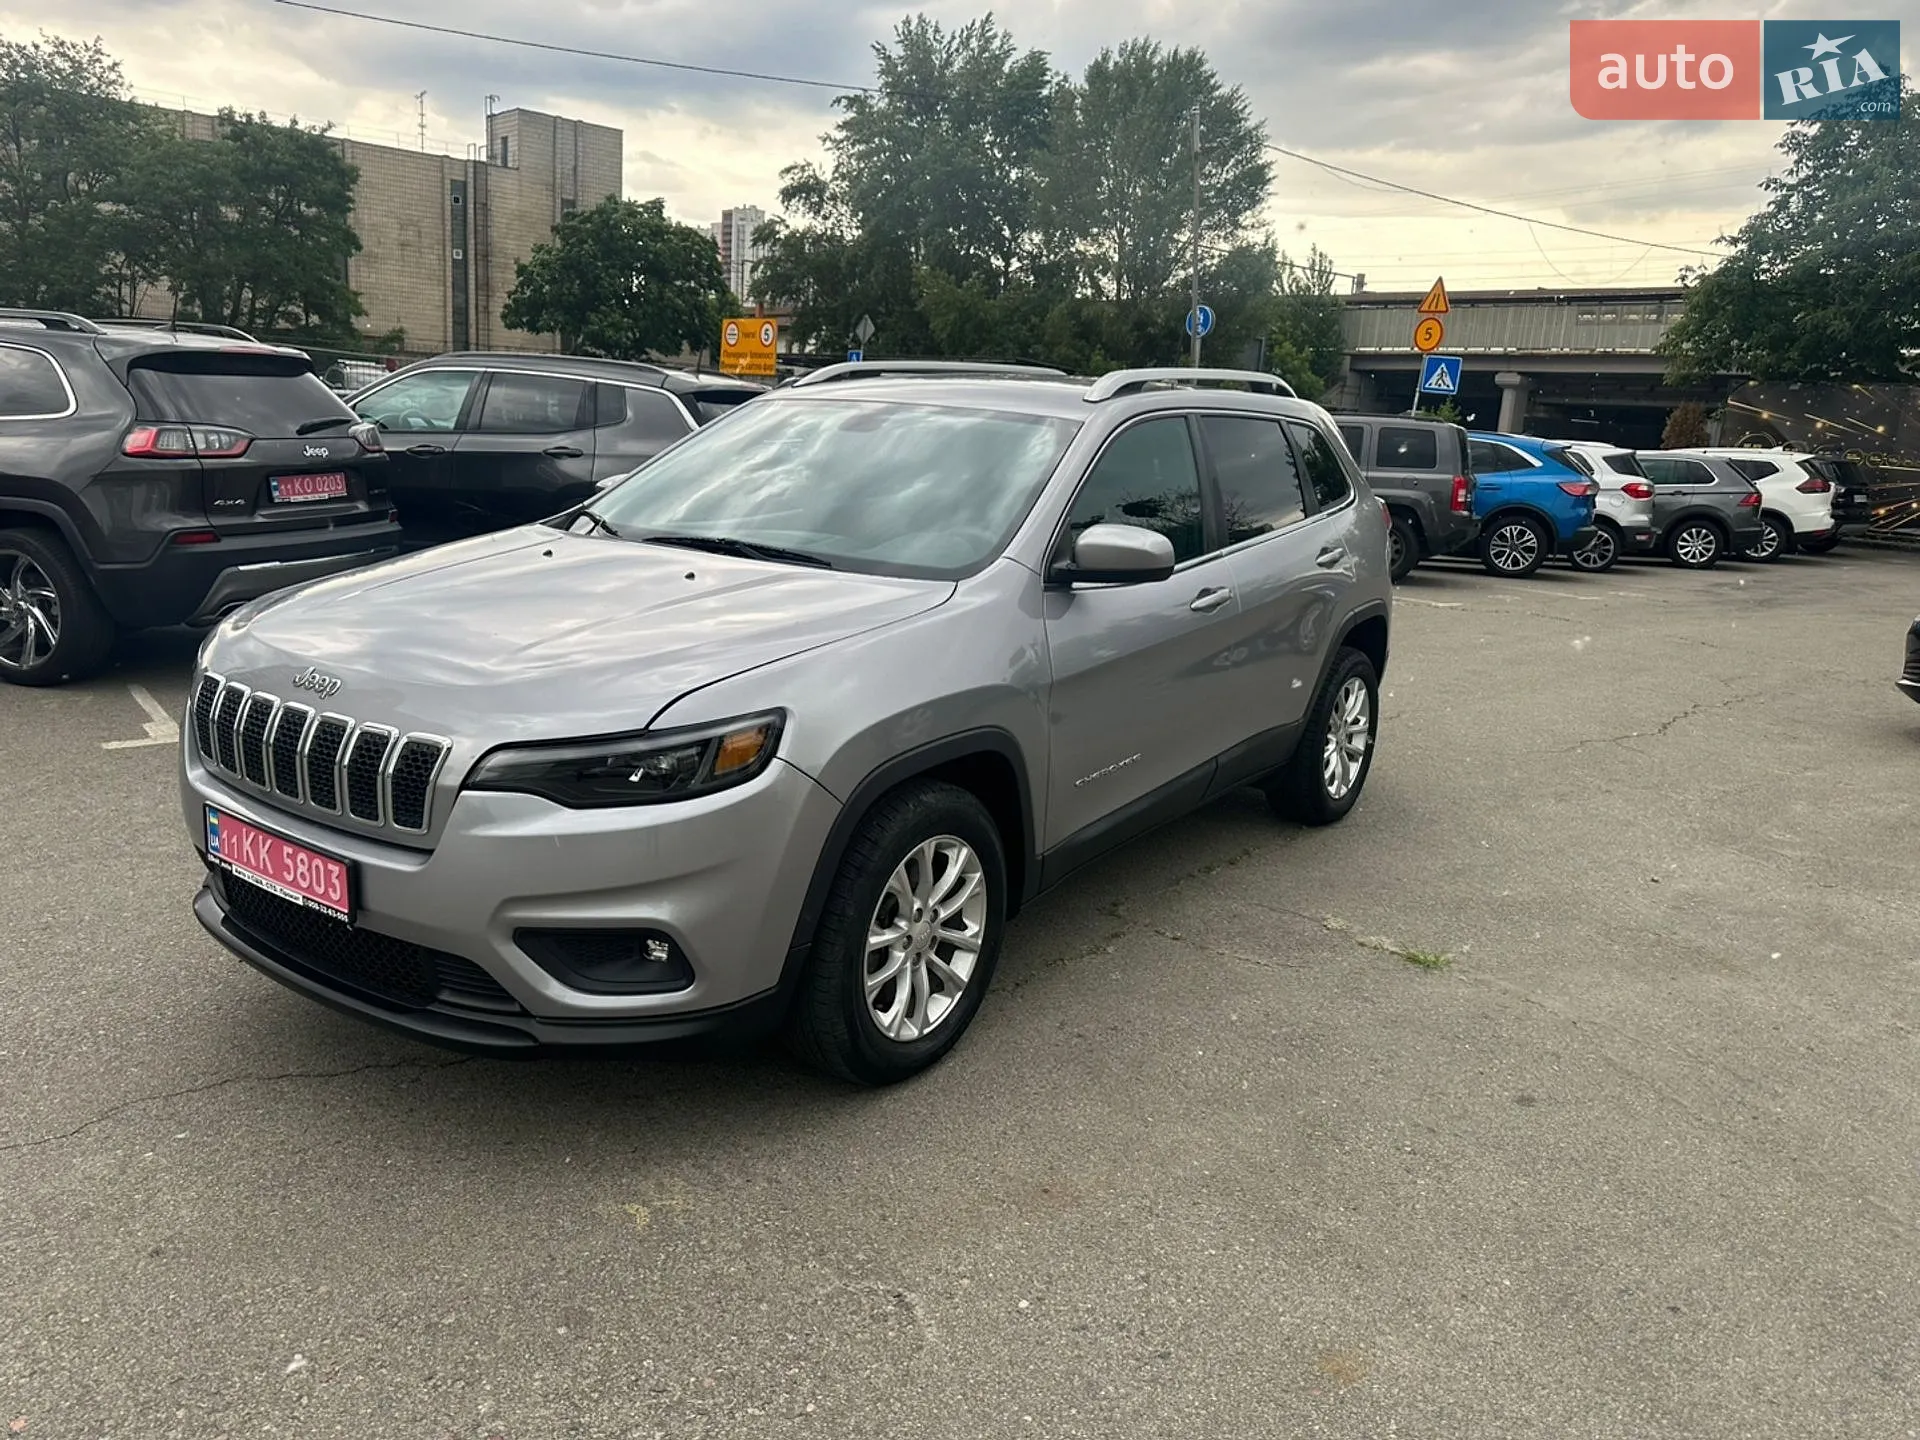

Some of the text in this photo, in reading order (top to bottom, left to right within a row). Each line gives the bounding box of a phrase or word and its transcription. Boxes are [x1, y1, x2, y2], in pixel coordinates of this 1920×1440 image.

[763, 327, 771, 342] 5
[1424, 327, 1433, 341] 5
[303, 445, 329, 458] Jeep
[316, 475, 343, 492] 0203
[293, 666, 342, 699] Jeep
[210, 834, 220, 849] UA
[283, 846, 342, 902] 5803
